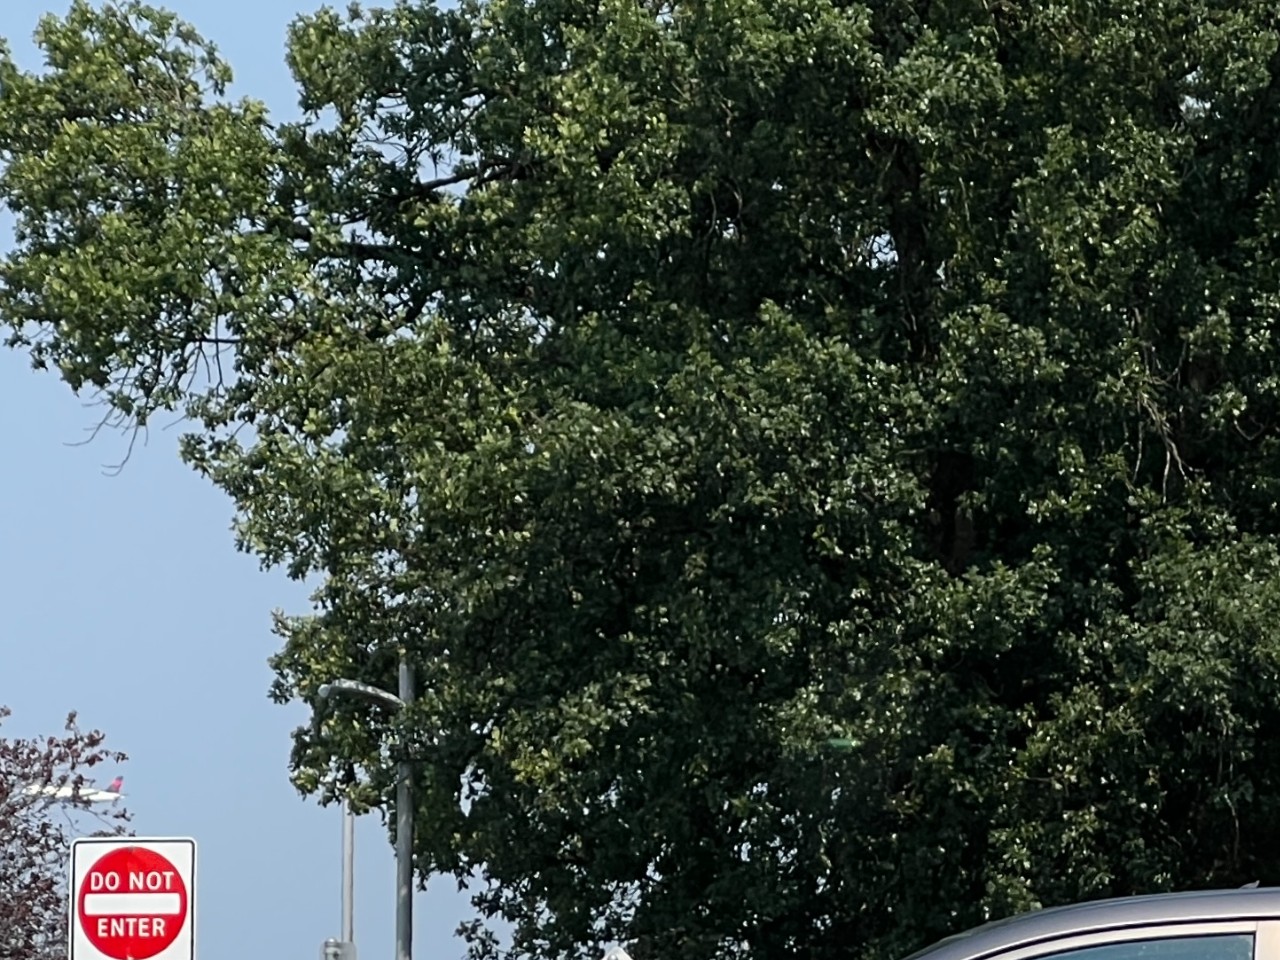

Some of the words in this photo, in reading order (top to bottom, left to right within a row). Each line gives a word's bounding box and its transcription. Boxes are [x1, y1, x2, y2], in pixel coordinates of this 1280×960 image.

[90, 871, 120, 891] DO
[129, 871, 174, 891] NOT
[97, 917, 165, 937] ENTER
